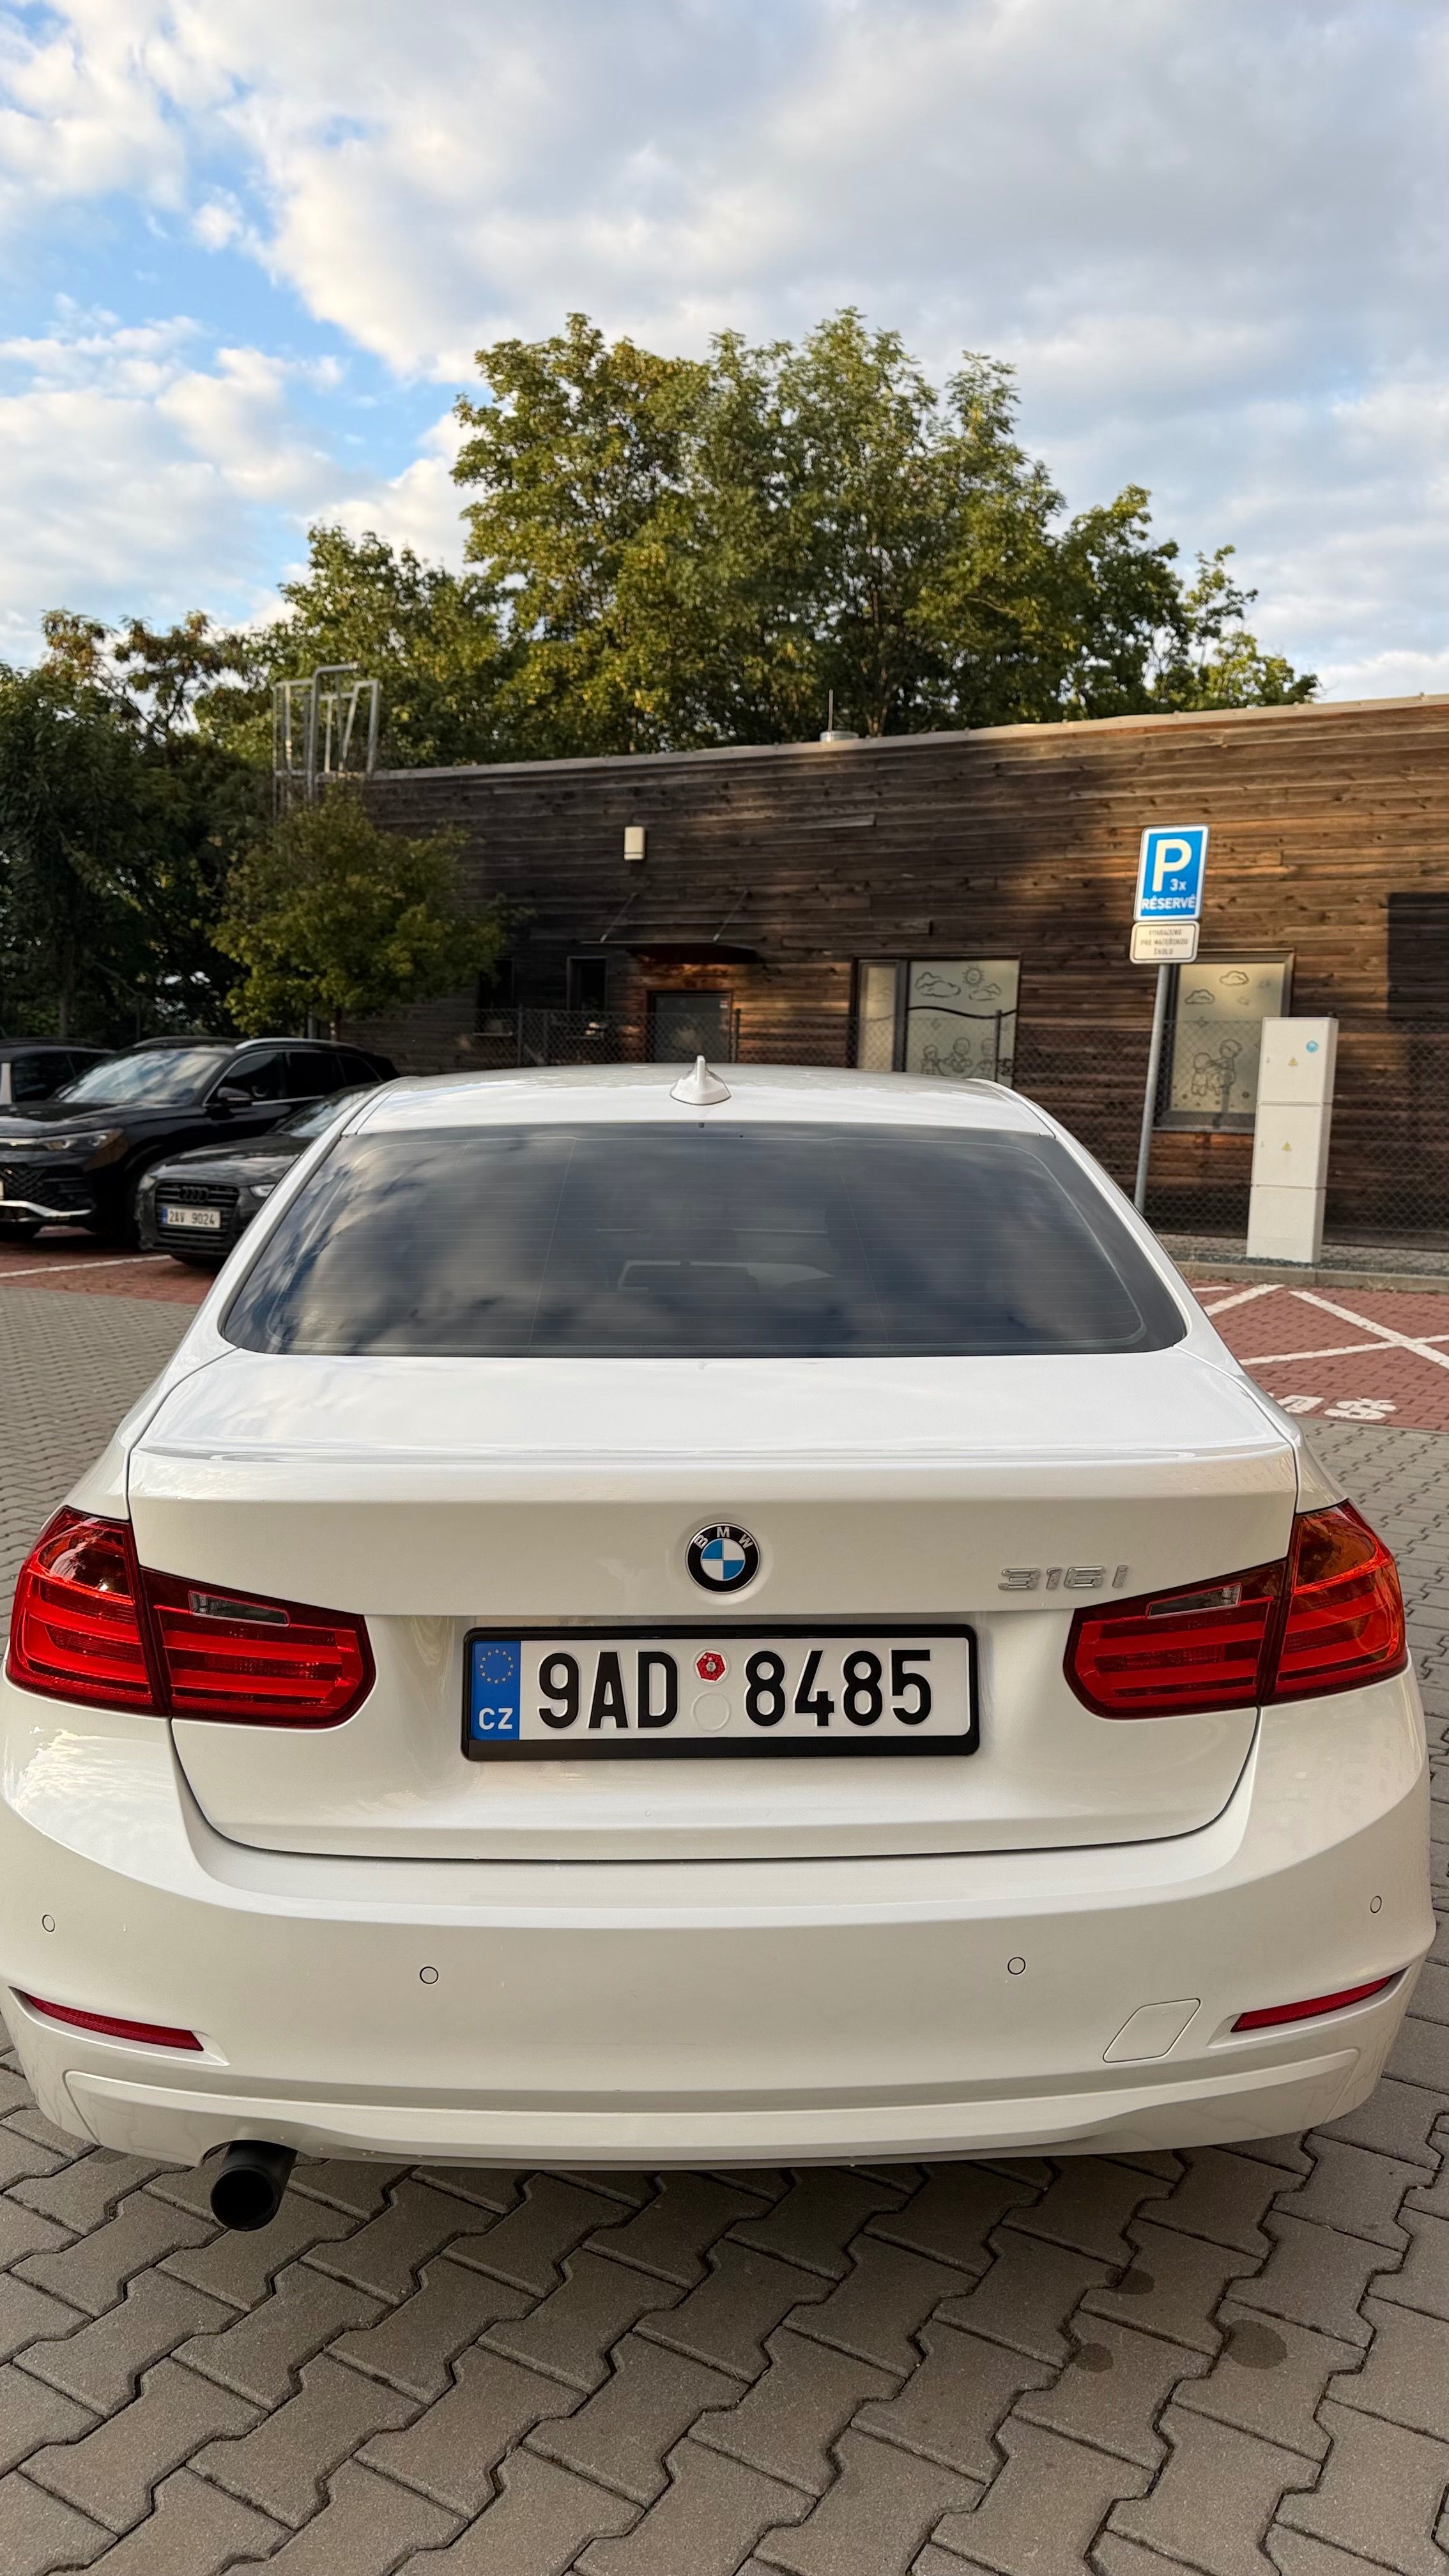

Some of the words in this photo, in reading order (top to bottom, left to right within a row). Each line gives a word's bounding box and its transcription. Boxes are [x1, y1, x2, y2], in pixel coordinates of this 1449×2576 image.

[1152, 839, 1192, 892] P
[1170, 878, 1187, 891] 3x
[1140, 894, 1197, 910] RÉSERVÉ
[192, 1212, 216, 1226] 9024
[693, 1526, 754, 1549] BMW
[539, 1651, 678, 1729] 9AD
[745, 1650, 932, 1728] 8485
[479, 1708, 513, 1729] CZ
